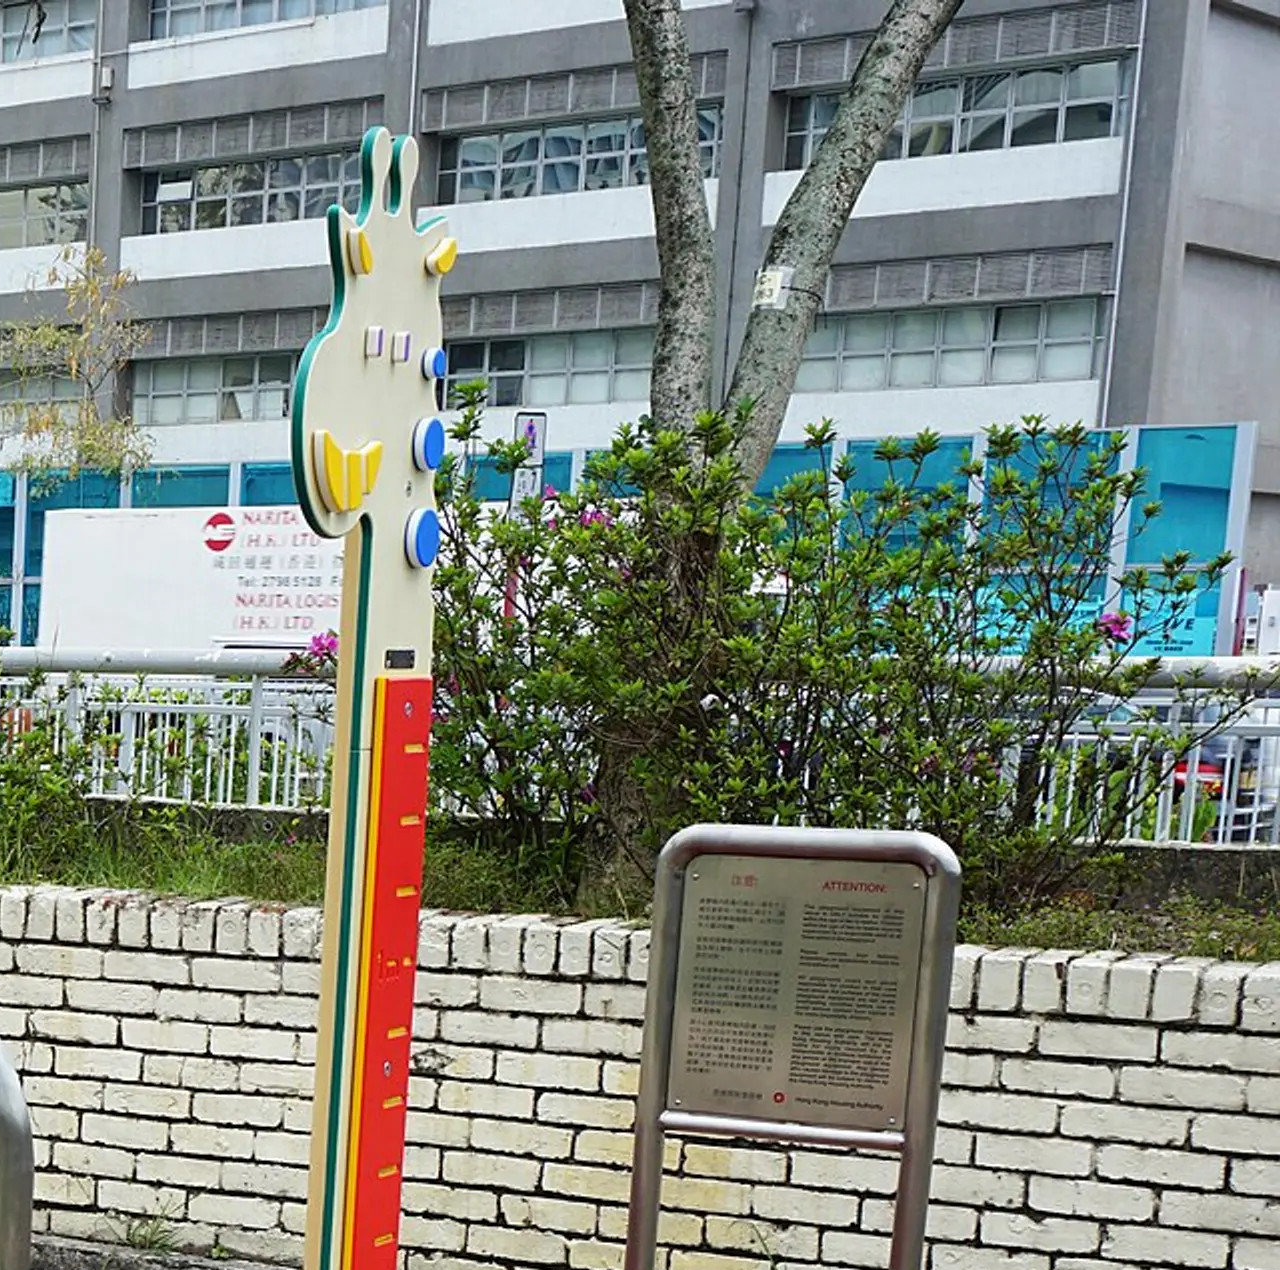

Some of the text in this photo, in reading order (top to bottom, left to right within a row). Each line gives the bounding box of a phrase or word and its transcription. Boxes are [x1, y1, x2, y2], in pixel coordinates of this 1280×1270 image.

[243, 511, 299, 525] NARITA
[236, 594, 340, 608] NARITA LOGIS
